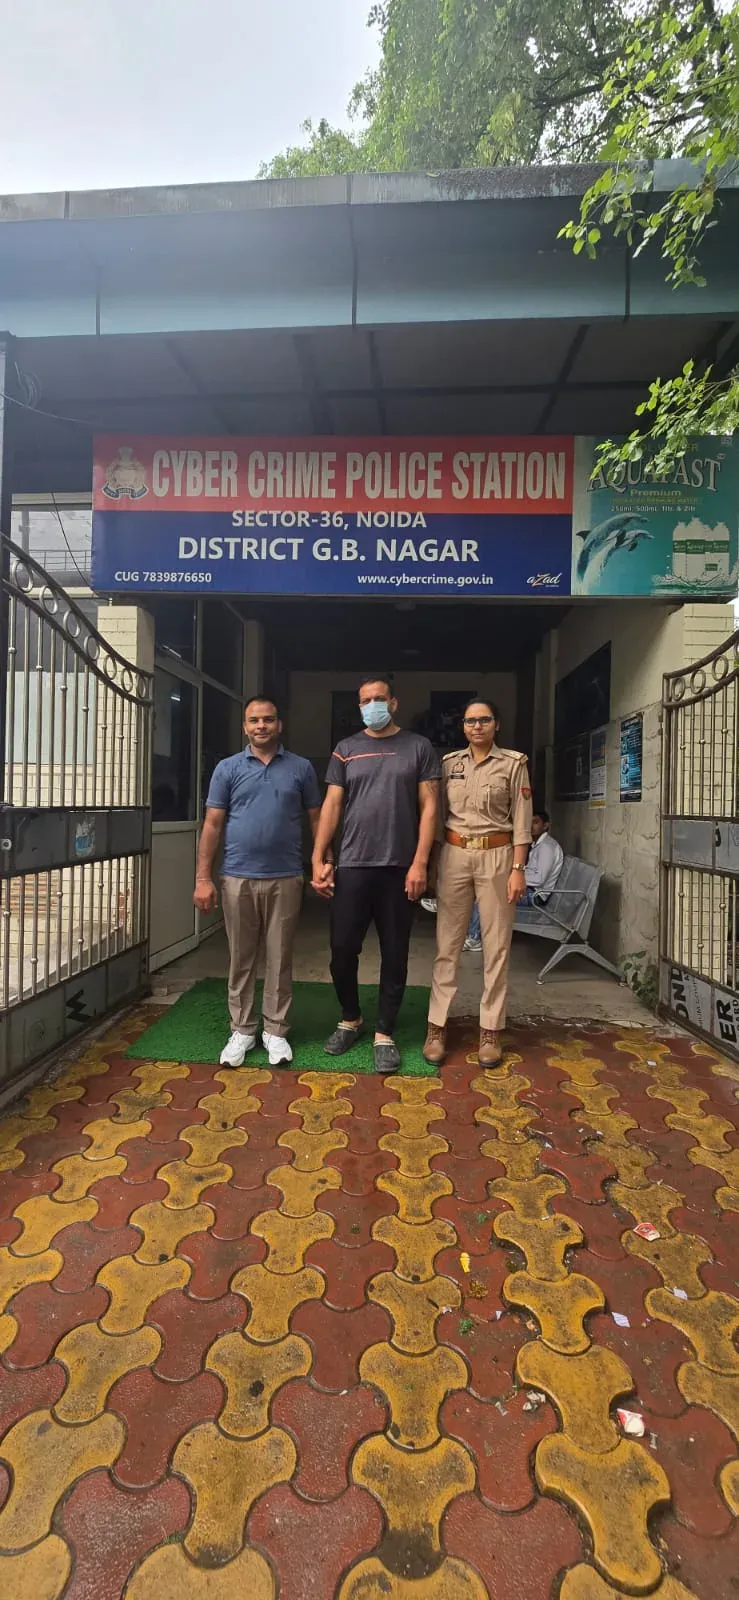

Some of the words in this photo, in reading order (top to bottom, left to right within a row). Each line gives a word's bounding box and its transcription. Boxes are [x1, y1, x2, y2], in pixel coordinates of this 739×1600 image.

[152, 450, 239, 498] CYBER
[248, 451, 337, 499] CRIME
[345, 451, 443, 500] POLICE
[451, 451, 566, 500] STATION
[630, 489, 682, 497] Premium
[232, 510, 349, 531] SECTOR-36,
[356, 511, 427, 528] NOIDA
[178, 536, 305, 561] DISTRICT
[312, 538, 366, 562] G.B.
[376, 538, 480, 562] NAGAR
[114, 571, 139, 582] CUG
[142, 571, 212, 583] 7839876650
[357, 573, 494, 587] www.cybercrime.gov.in
